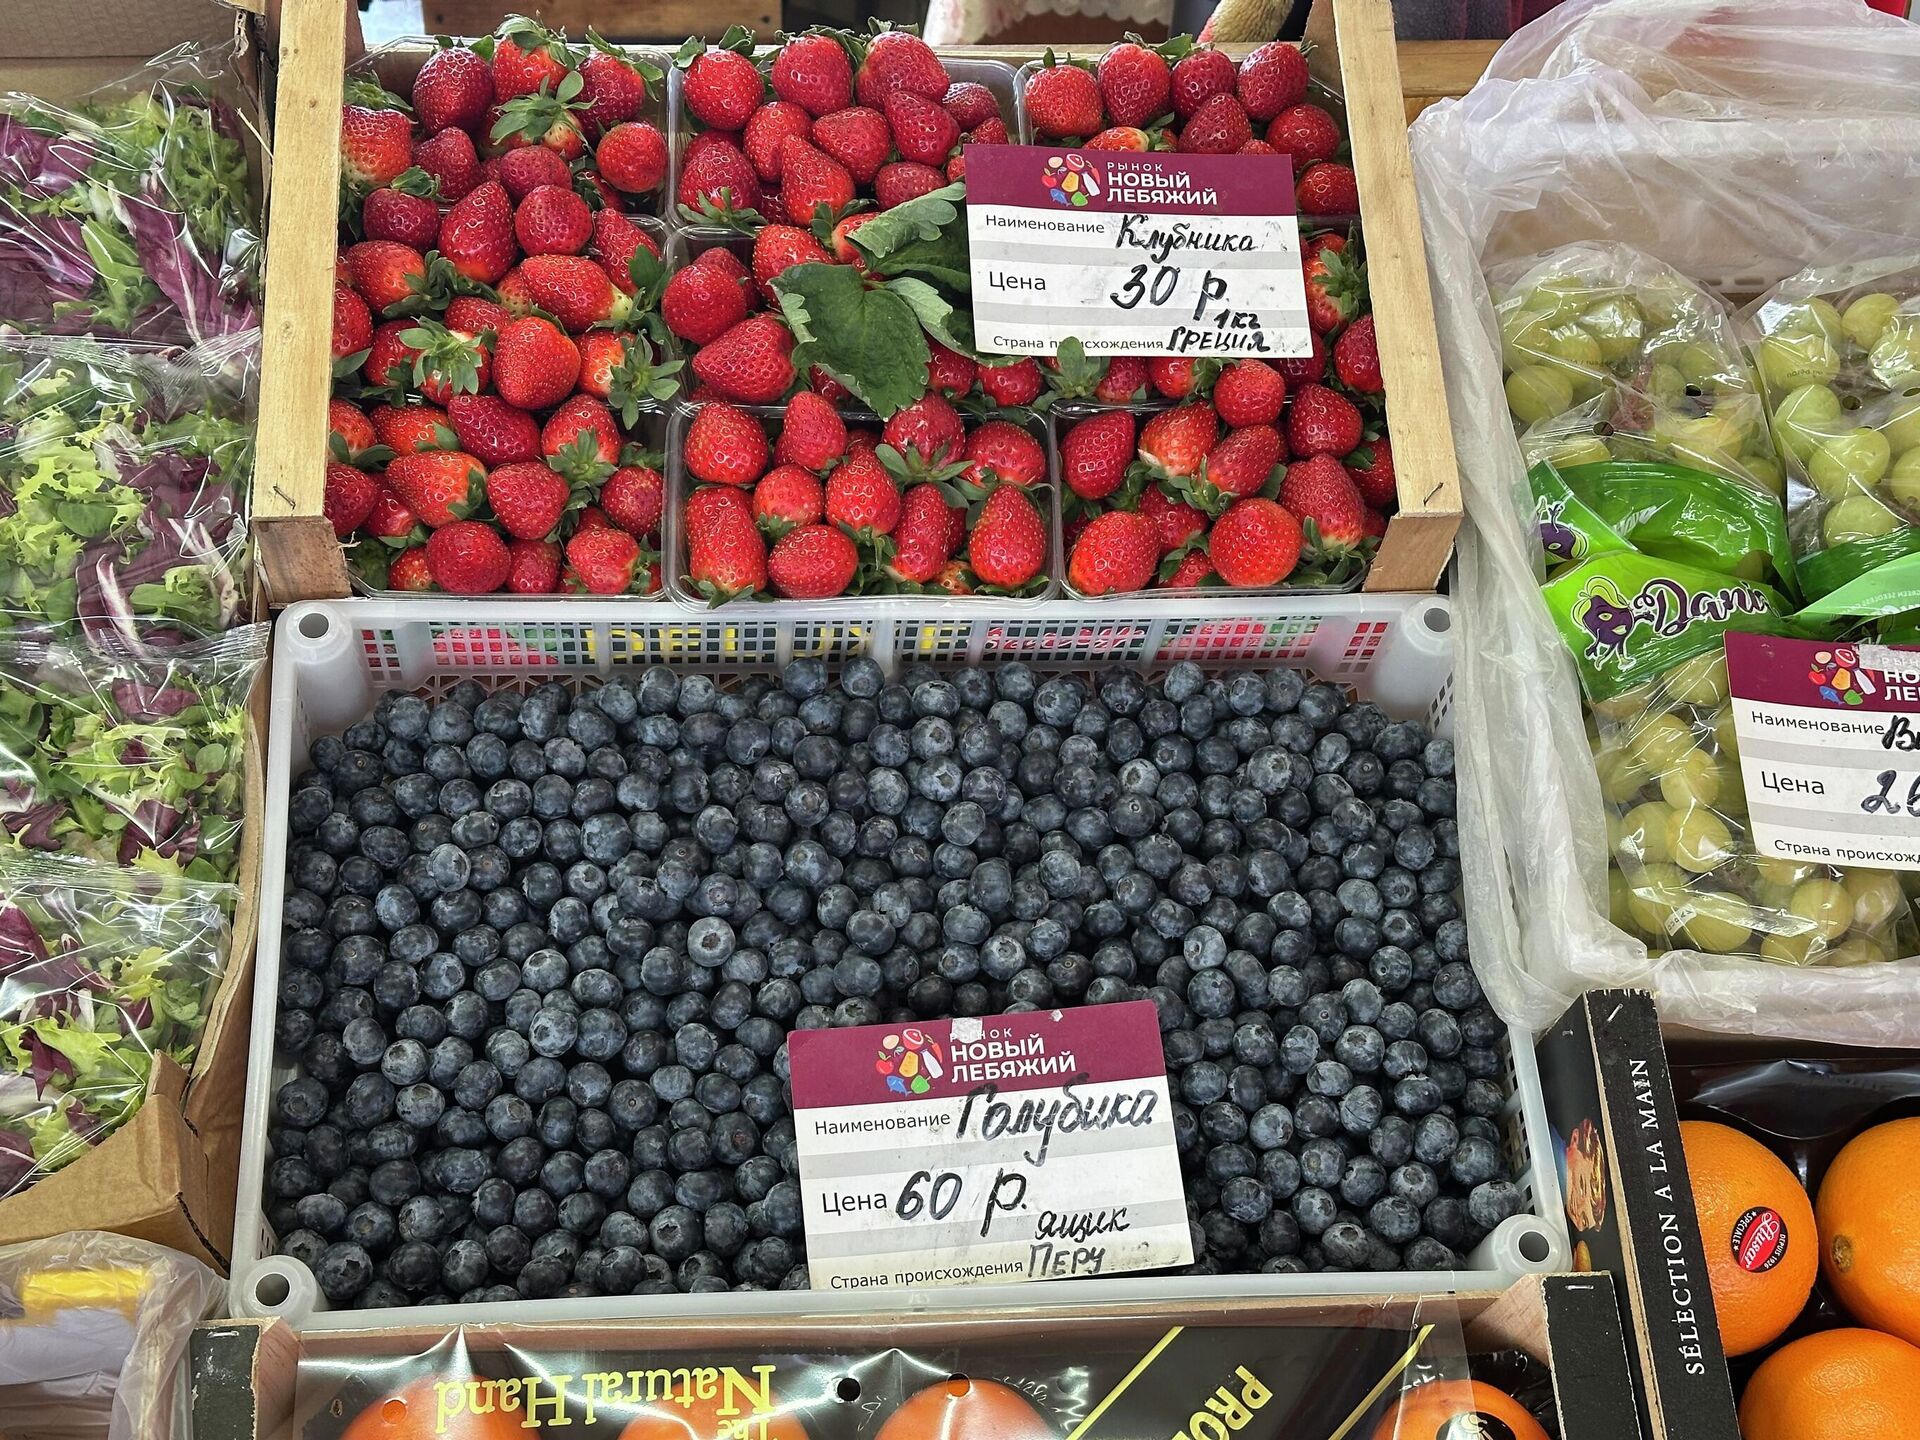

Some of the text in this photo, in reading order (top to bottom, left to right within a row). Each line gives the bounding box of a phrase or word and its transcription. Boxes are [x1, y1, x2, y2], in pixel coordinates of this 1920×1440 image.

[1107, 161, 1163, 172] РЫНОК
[1108, 171, 1190, 188] НОВЫЙ
[1107, 188, 1217, 205] ЛЕБЯЖИЙ
[986, 214, 1257, 263] Наименование Клубника
[989, 271, 1046, 291] Цена
[1110, 263, 1180, 309] 30
[993, 335, 1044, 349] Страна
[1049, 338, 1163, 351] псхождения
[1884, 686, 1920, 702] ЛЕ
[1752, 711, 1885, 735] Наименование
[1761, 771, 1825, 795] Цена
[1774, 840, 1830, 856] Страна
[949, 1028, 1013, 1043] РНОК
[951, 1033, 1045, 1062] НОВЫЙ
[951, 1050, 1076, 1084] ЛЕБЯЖИЙ
[1630, 1059, 1659, 1129] MAIN
[815, 1072, 1160, 1168] Наименование Голубика
[1646, 1140, 1668, 1181] LA
[822, 1192, 888, 1217] Цена
[896, 1170, 962, 1221] 60
[1763, 1234, 1786, 1269] DEPUIS 1926
[830, 1272, 888, 1289] Страна
[894, 1260, 1024, 1287] происхождения
[433, 1365, 776, 1433] Natural Hand
[1170, 1365, 1273, 1440] PRO
